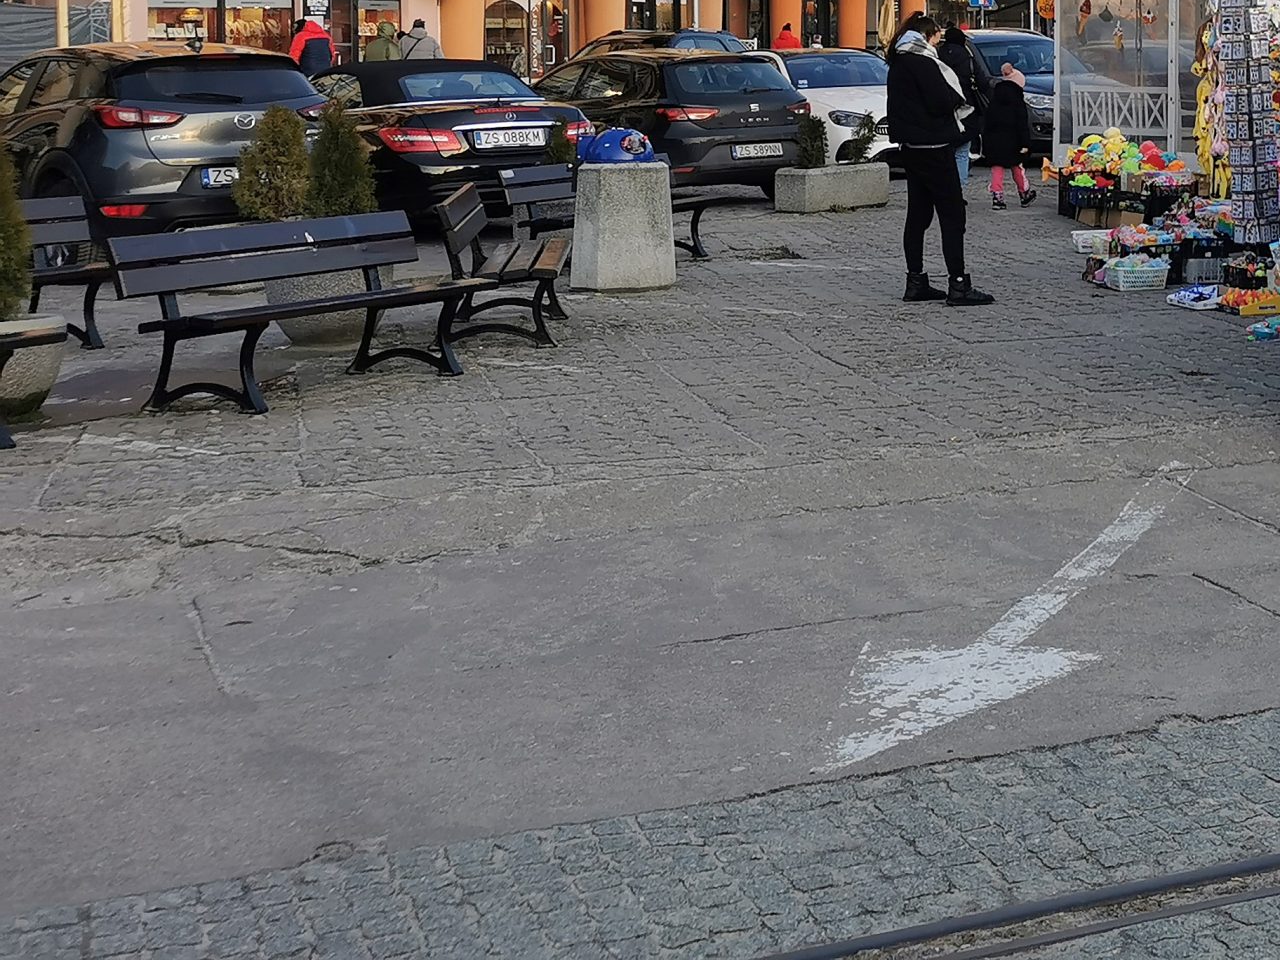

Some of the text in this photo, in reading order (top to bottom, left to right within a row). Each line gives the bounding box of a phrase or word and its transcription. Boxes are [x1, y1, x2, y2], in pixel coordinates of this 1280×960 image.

[484, 131, 541, 145] ZS 088KM
[738, 144, 782, 156] ZS 589NN
[212, 169, 235, 184] ZS
